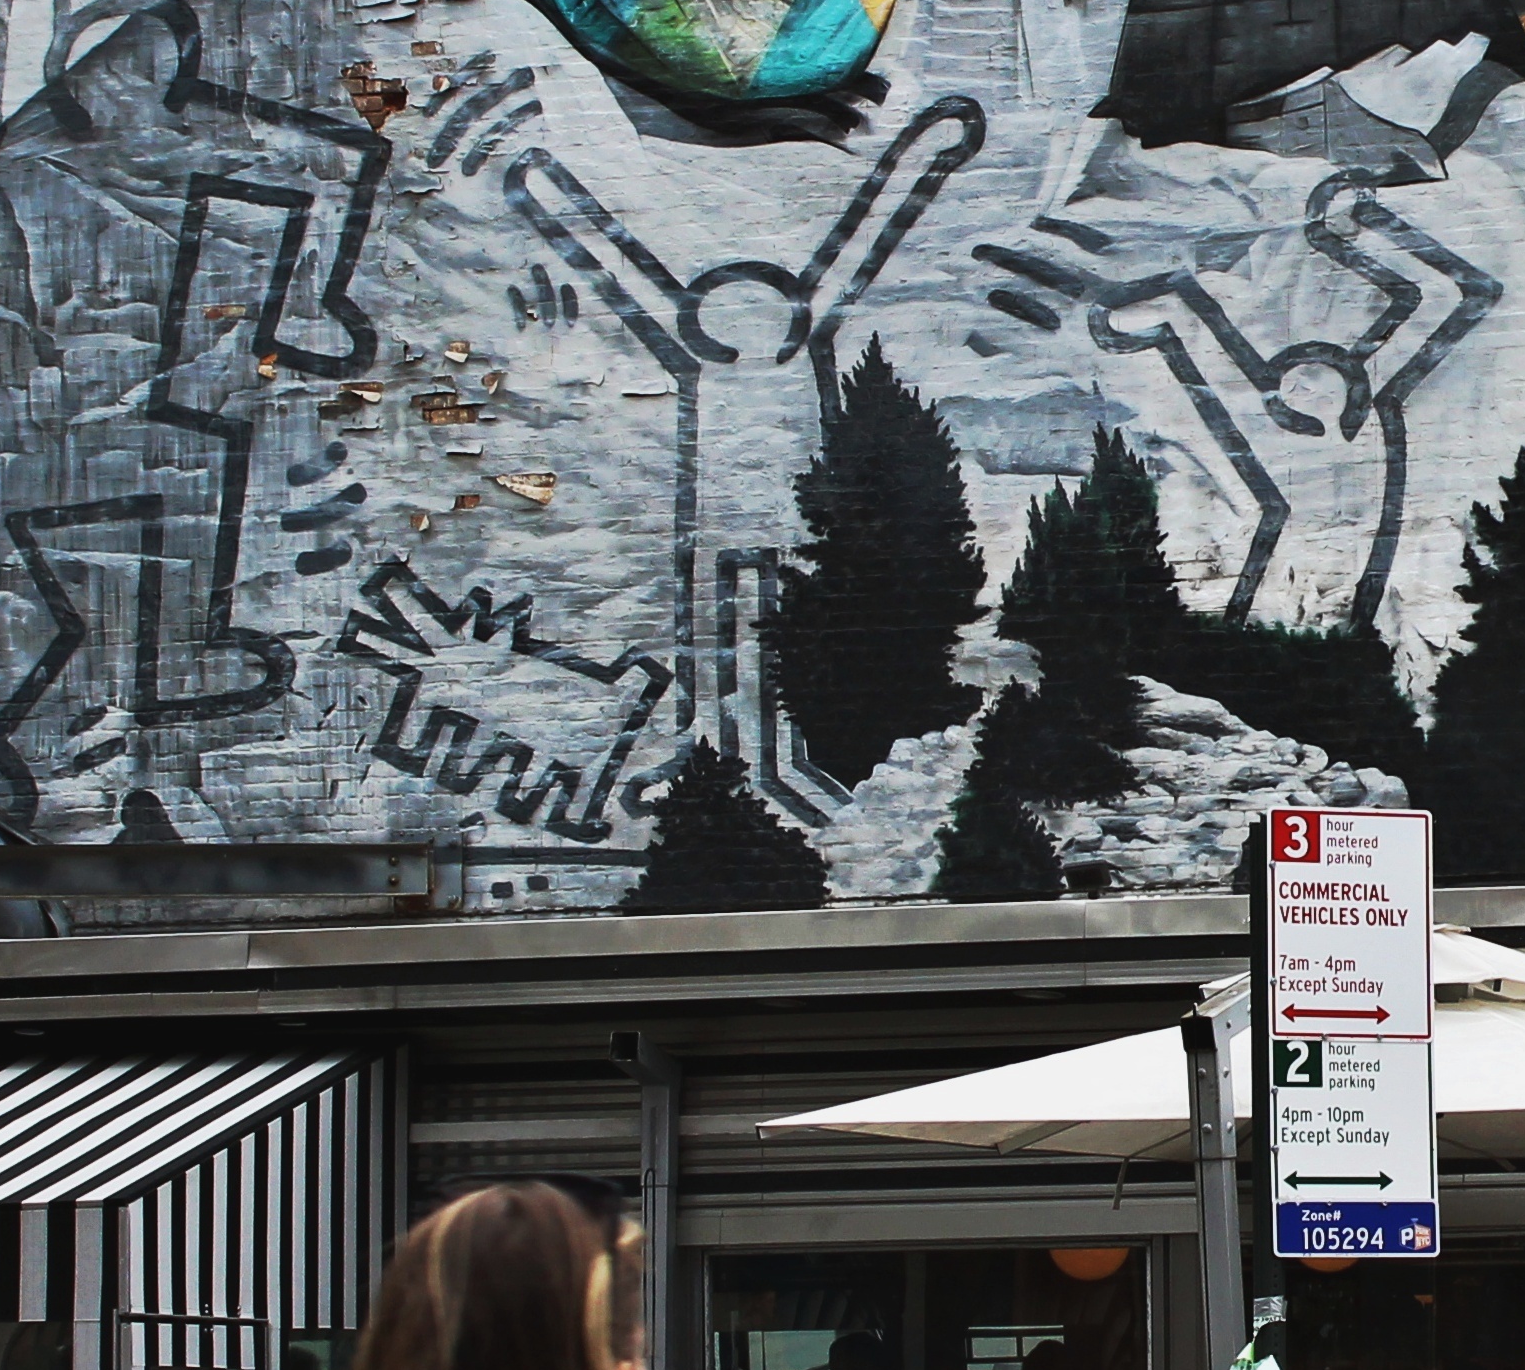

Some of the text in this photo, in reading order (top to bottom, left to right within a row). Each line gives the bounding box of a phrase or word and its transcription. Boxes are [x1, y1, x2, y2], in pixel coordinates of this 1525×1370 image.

[1326, 819, 1354, 832] hour
[1283, 816, 1309, 859] 3
[1326, 836, 1379, 849] metered
[1326, 851, 1372, 868] parking
[1278, 881, 1390, 902] COMMERCIAL
[1279, 906, 1408, 927] VEHICLES ONLY
[1279, 954, 1309, 970] 7am
[1325, 955, 1356, 975] 4pm
[1279, 976, 1384, 997] Except Sunday
[1328, 1042, 1356, 1055] hour
[1286, 1041, 1310, 1083] 2
[1328, 1059, 1381, 1072] metered
[1329, 1075, 1376, 1091] parking
[1281, 1106, 1312, 1125] 4pm
[1327, 1106, 1364, 1125] 10pm
[1281, 1127, 1390, 1147] Except Sunday
[1301, 1209, 1342, 1222] Zone#
[1302, 1227, 1384, 1250] 105294
